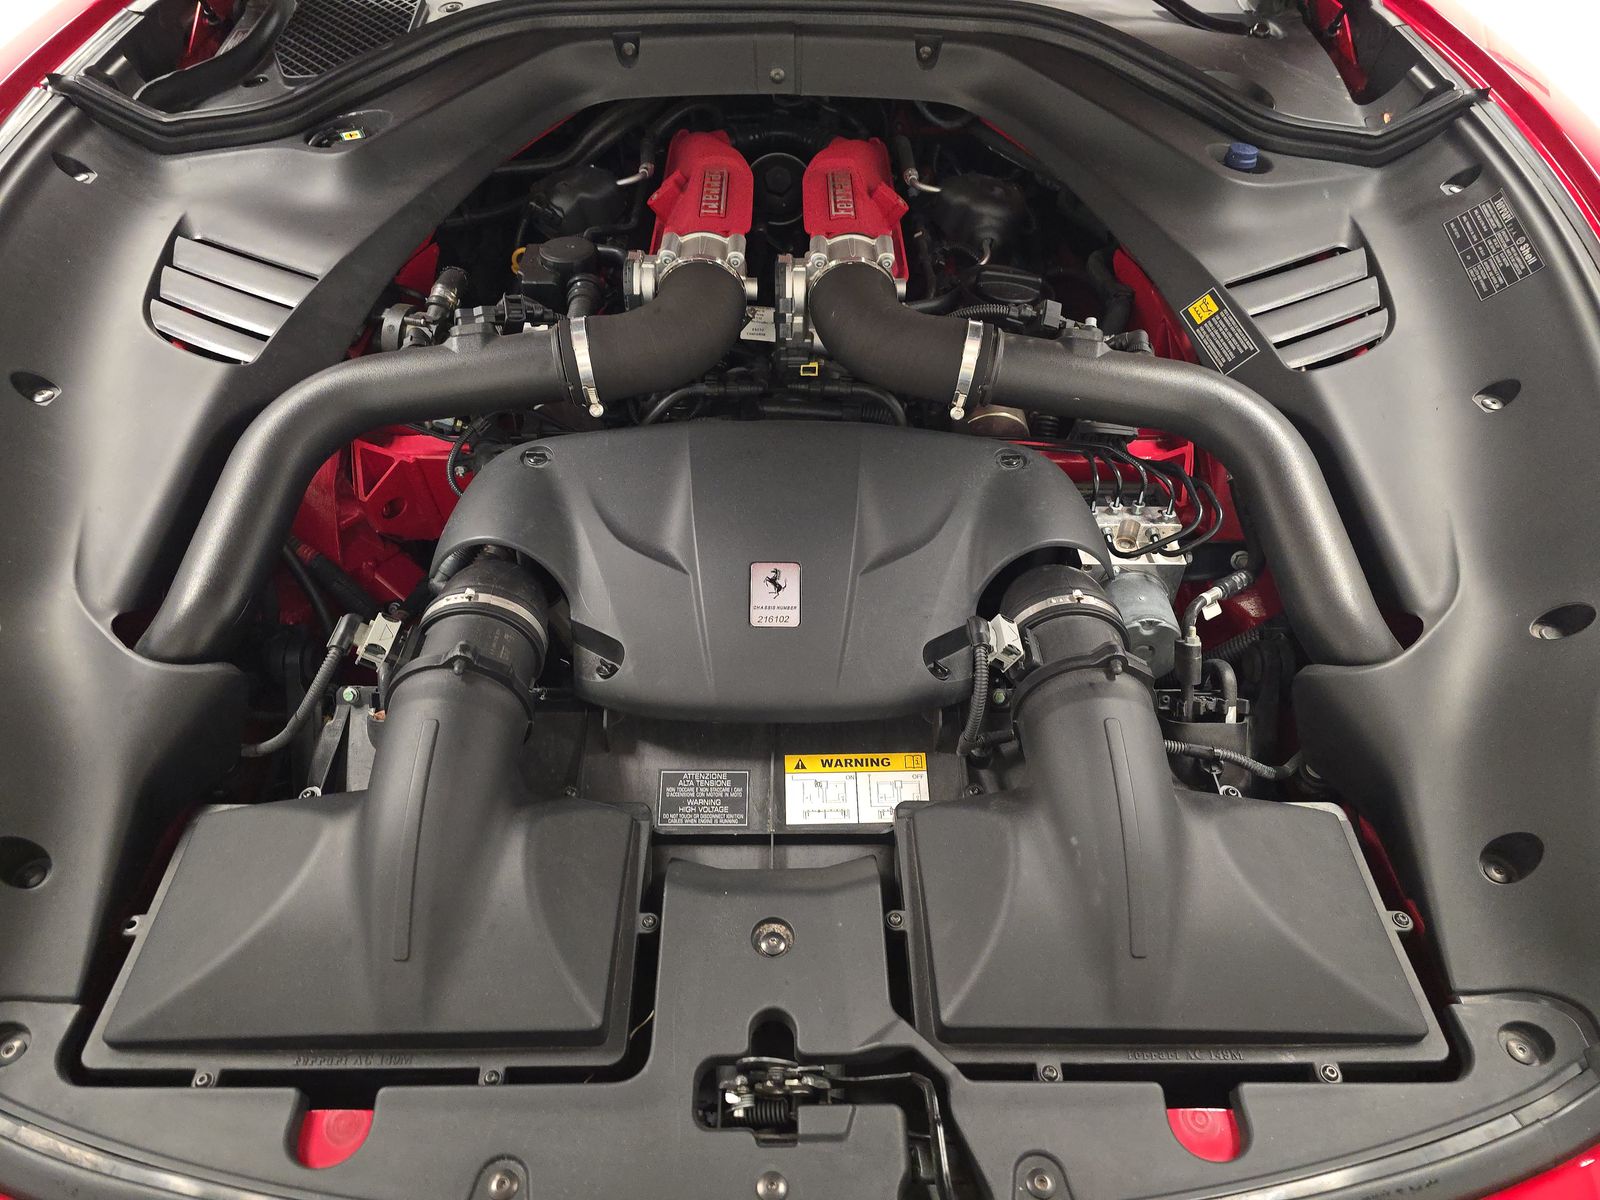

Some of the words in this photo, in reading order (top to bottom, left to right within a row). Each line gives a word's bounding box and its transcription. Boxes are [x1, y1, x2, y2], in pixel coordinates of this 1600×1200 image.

[1494, 197, 1515, 223] Ferrari
[1519, 243, 1537, 265] Shell
[757, 615, 790, 623] 216102
[820, 757, 891, 768] WARNING
